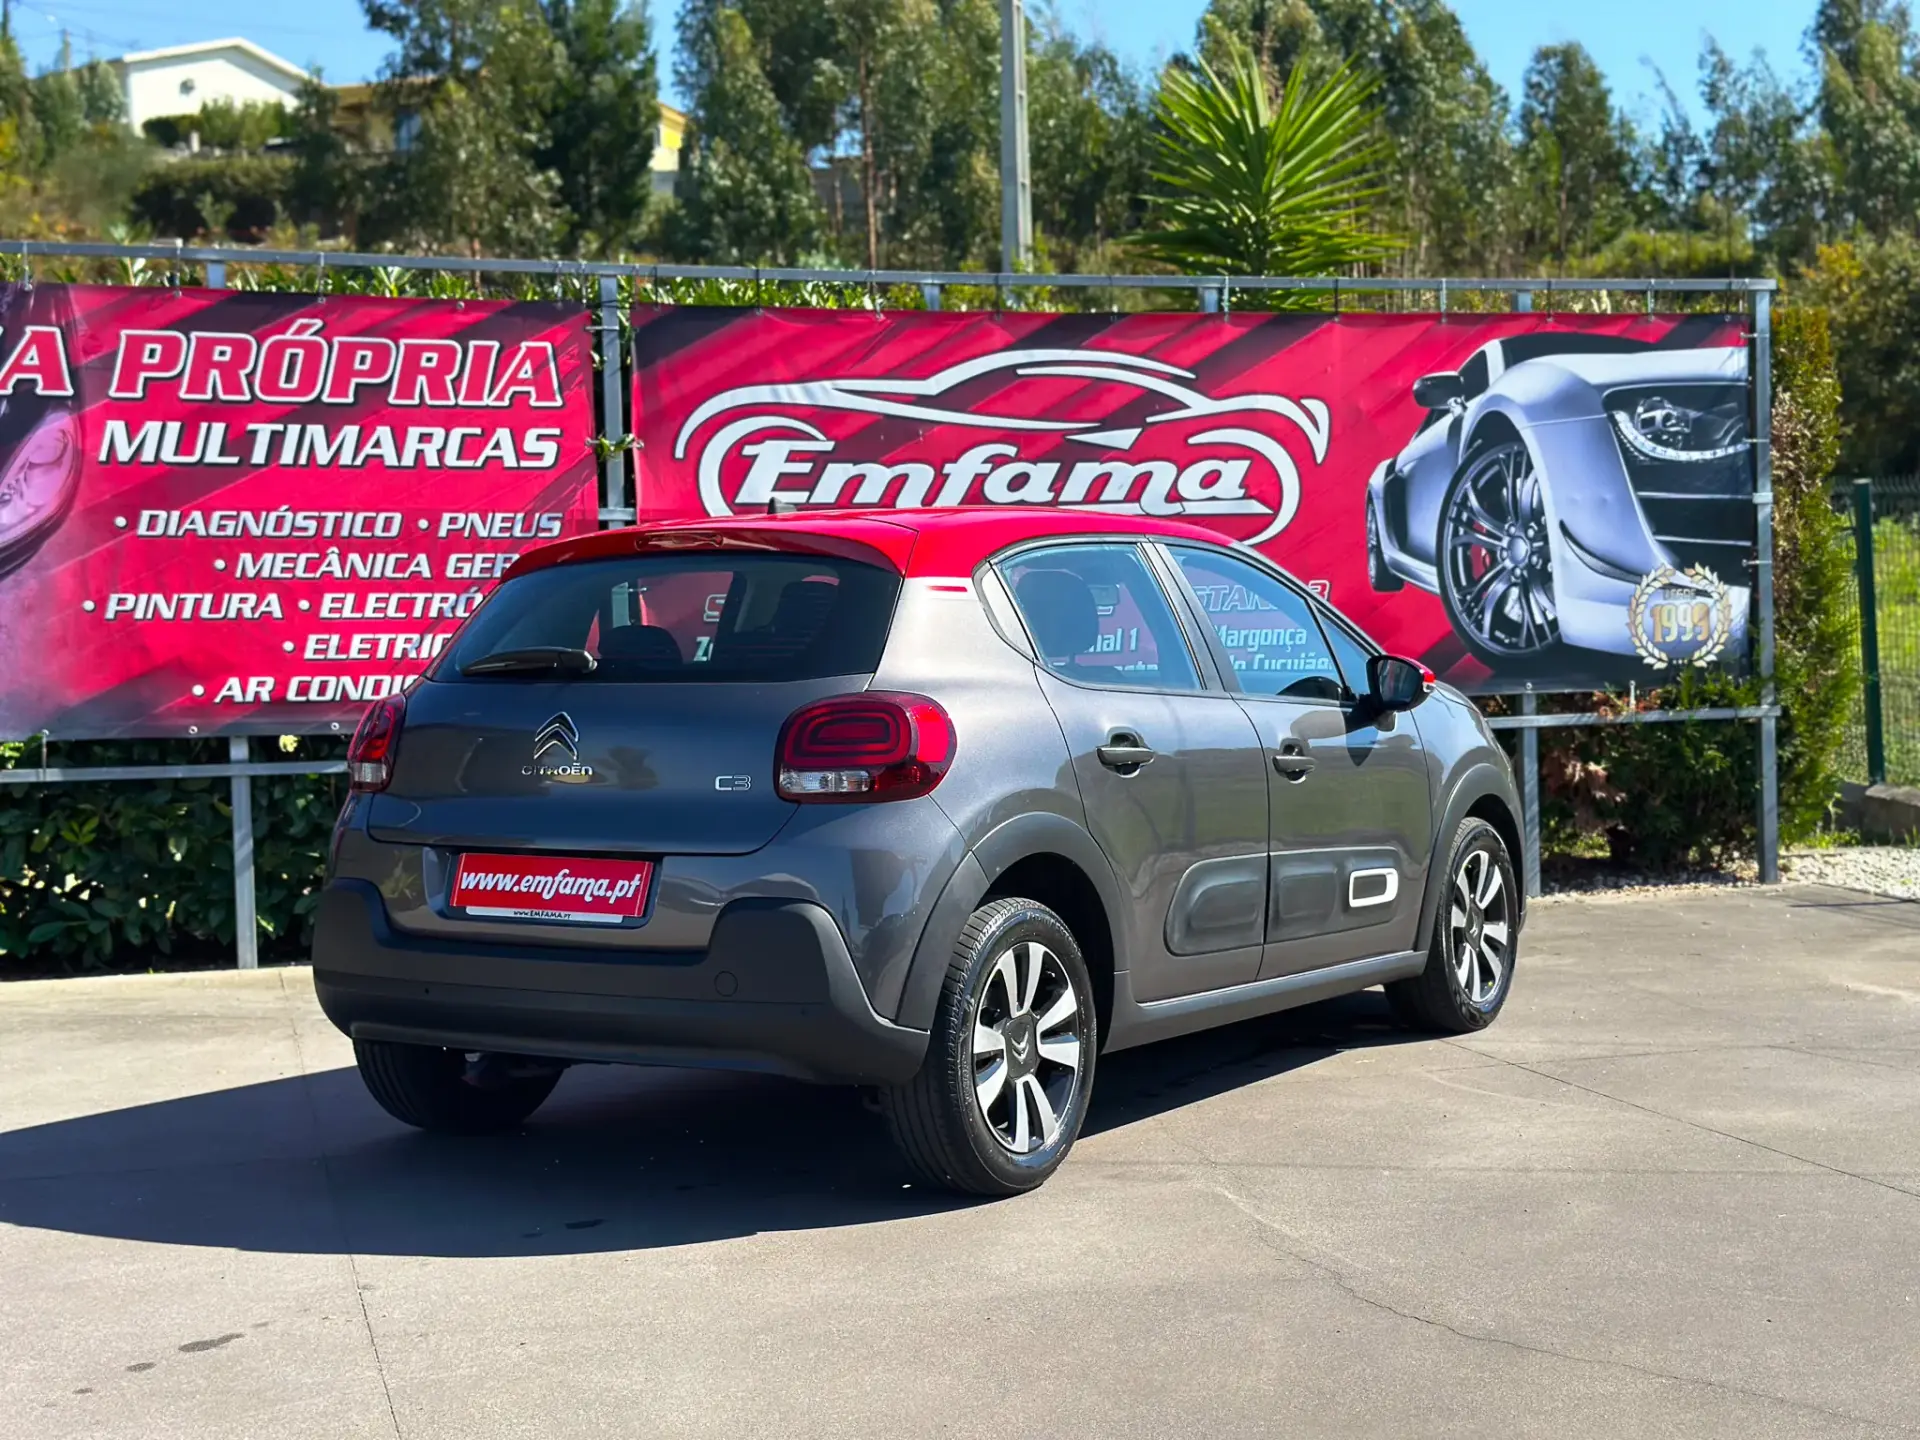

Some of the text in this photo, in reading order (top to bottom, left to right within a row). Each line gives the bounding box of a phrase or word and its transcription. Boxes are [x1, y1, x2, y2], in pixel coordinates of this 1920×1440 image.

[0, 319, 564, 408] A PRÓPRIA
[99, 420, 561, 469] MULTIMARCAS
[733, 440, 1251, 515] Emfama
[138, 505, 564, 538] DIAGNÓSTICO PNEUS
[235, 546, 432, 579] MECÂNICA
[104, 593, 283, 620] PINTURA
[1651, 602, 1710, 644] 1999
[214, 676, 274, 703] AR
[715, 775, 752, 790] C3
[460, 868, 642, 905] www.emfama.pt
